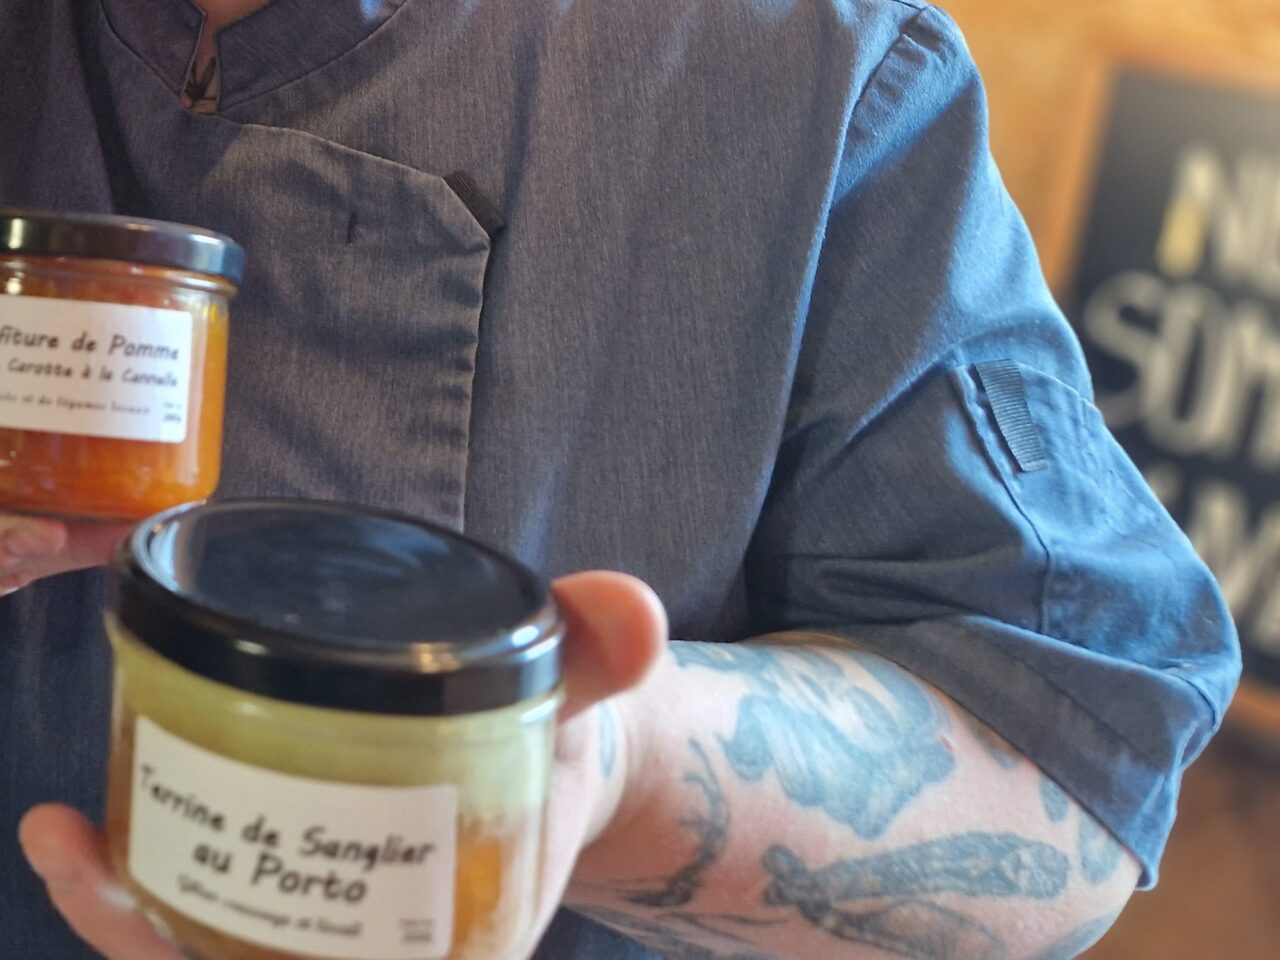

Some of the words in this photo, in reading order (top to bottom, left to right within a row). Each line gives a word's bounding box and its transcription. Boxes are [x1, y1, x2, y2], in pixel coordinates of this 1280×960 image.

[8, 358, 72, 378] Carotte
[72, 330, 97, 352] de
[109, 334, 178, 360] Pomme
[140, 764, 224, 831] Terrine
[241, 814, 278, 847] de
[298, 825, 436, 871] Sanglier
[193, 843, 231, 875] au
[251, 851, 368, 905] Porto
